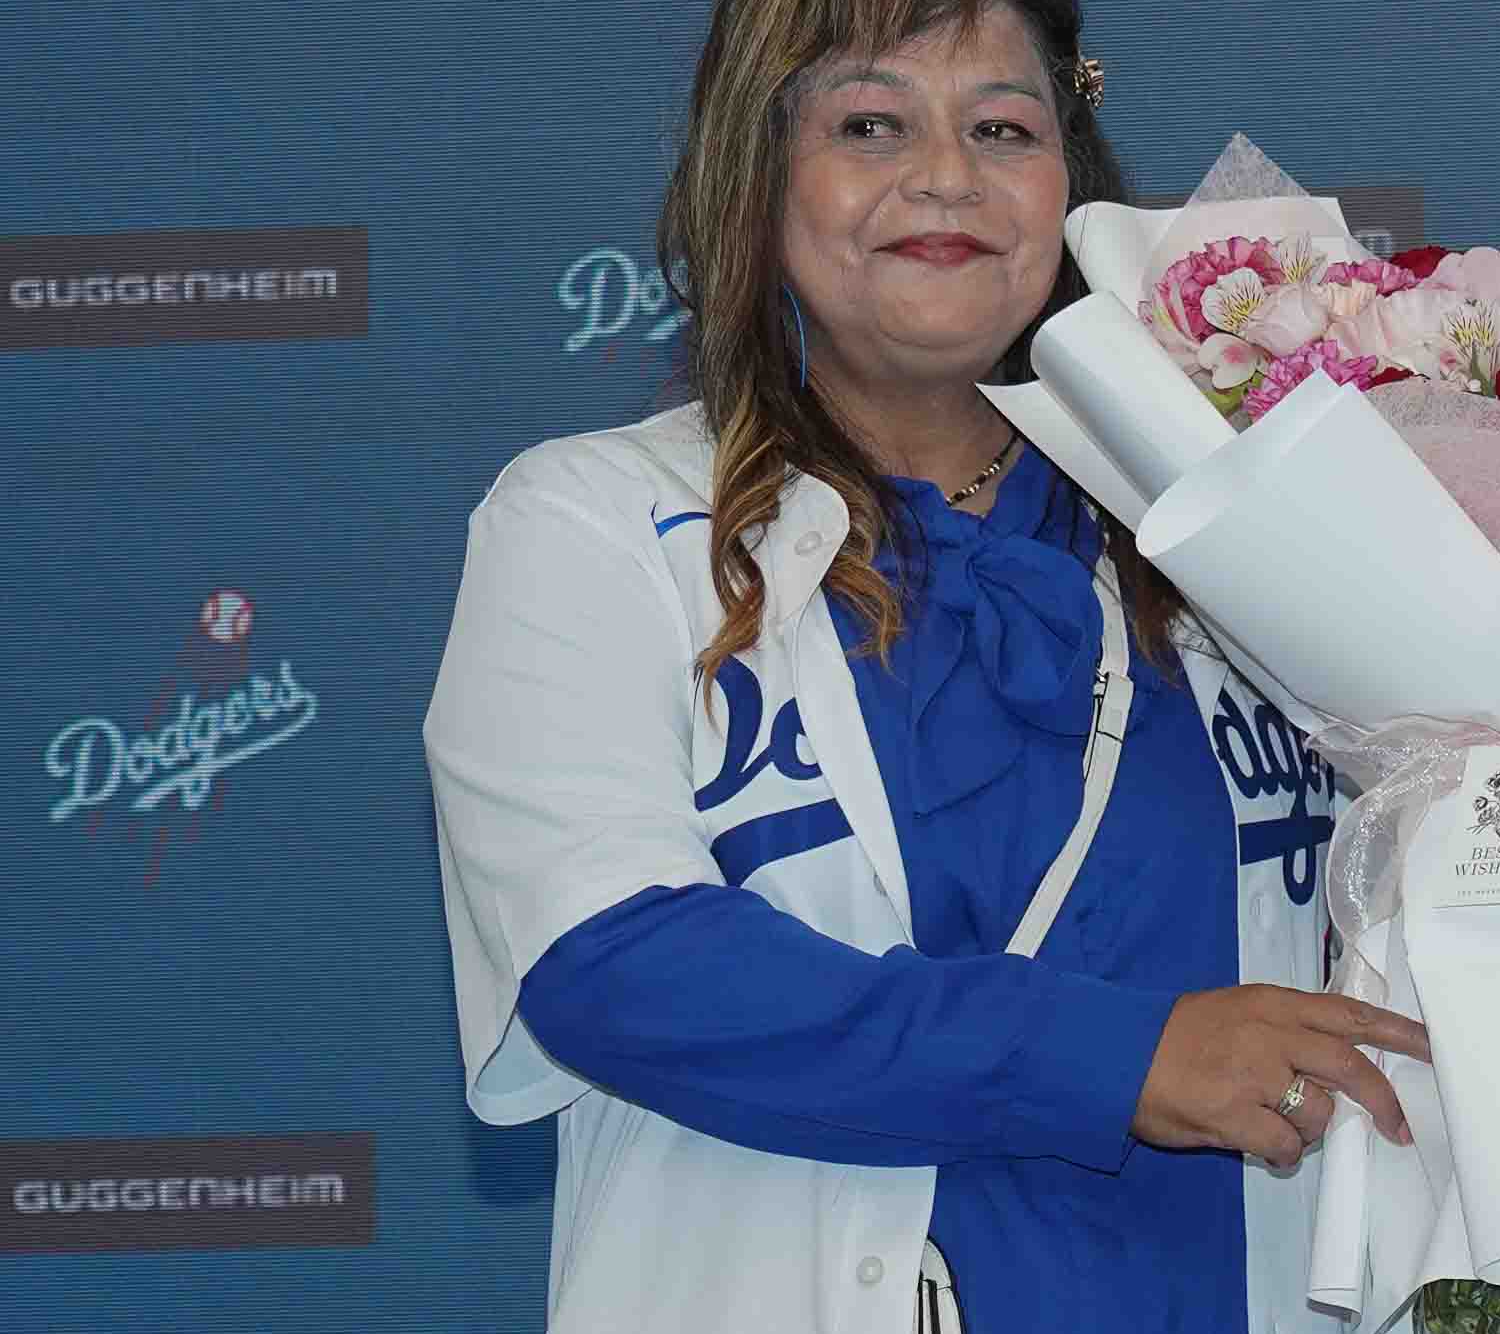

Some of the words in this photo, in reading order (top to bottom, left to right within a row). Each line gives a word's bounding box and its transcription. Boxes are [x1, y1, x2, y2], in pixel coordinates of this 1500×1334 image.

[9, 267, 338, 310] GUGGENHEIM
[45, 661, 317, 822] Dodgers
[13, 1175, 345, 1214] GUGGENHEIM
